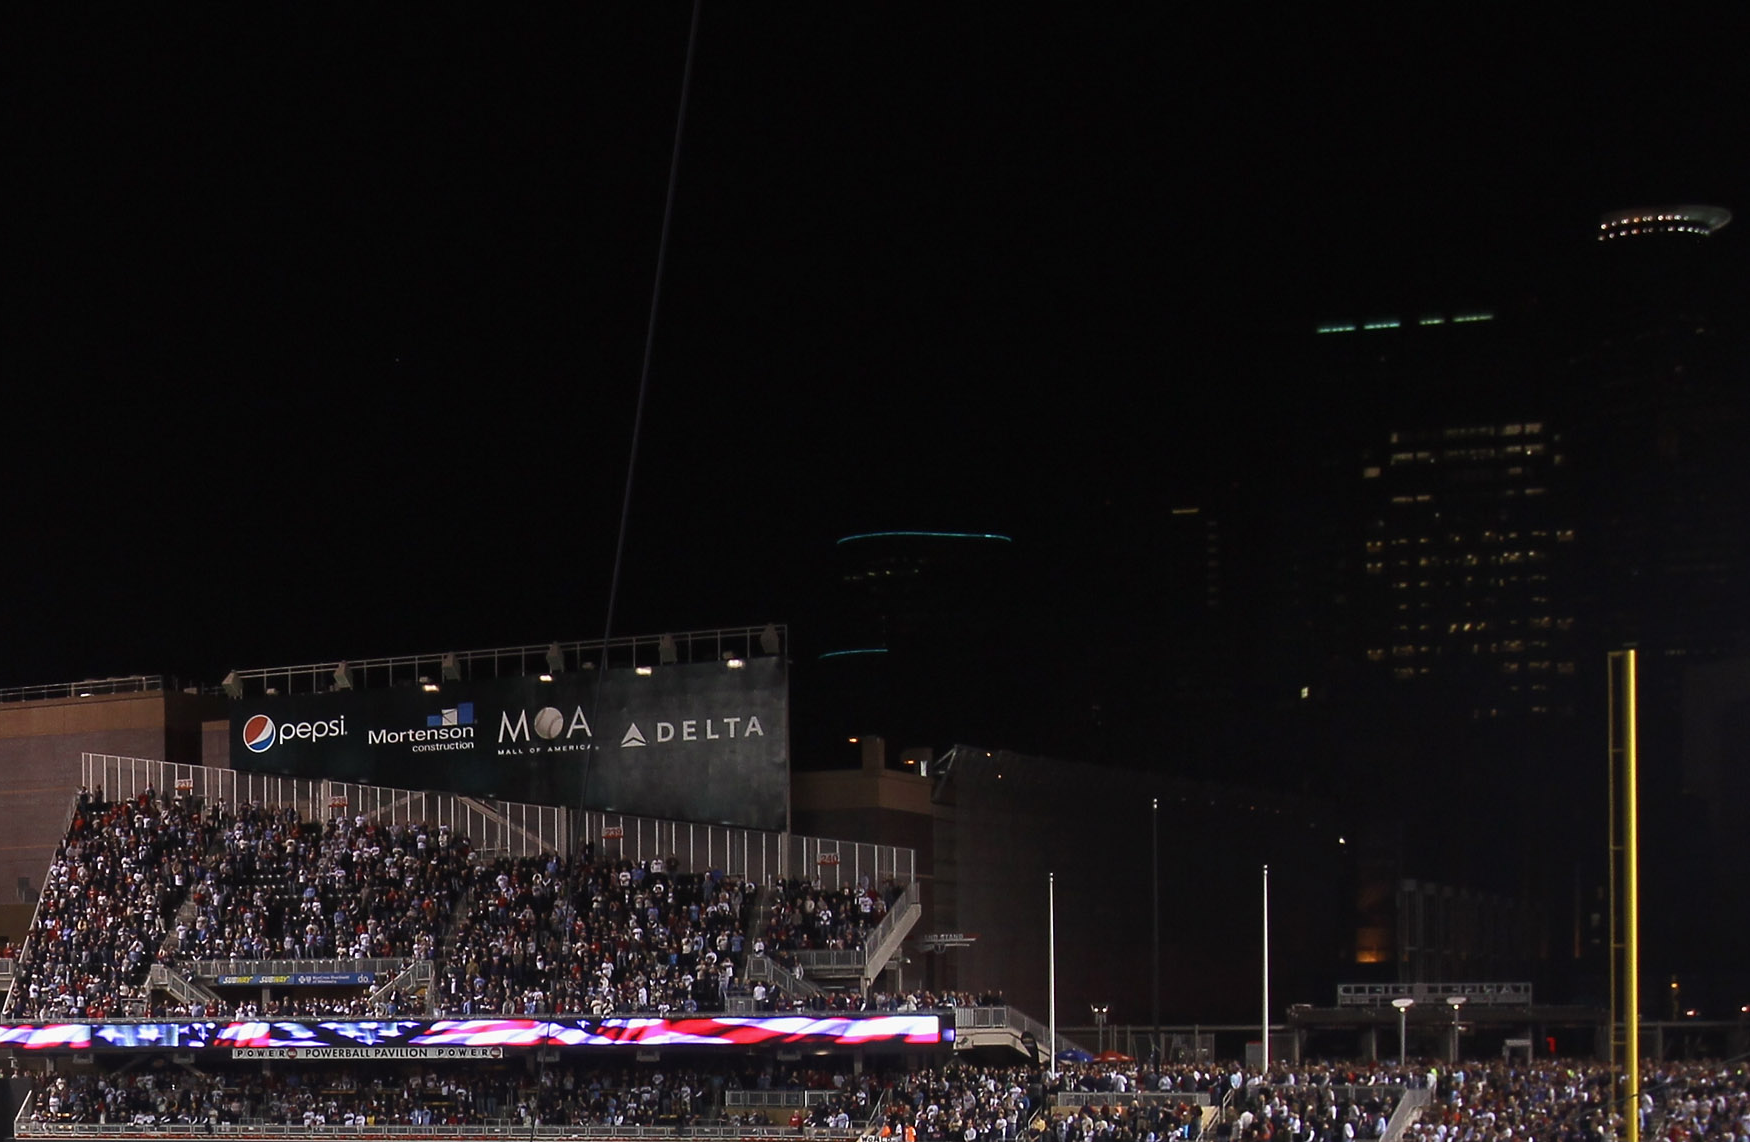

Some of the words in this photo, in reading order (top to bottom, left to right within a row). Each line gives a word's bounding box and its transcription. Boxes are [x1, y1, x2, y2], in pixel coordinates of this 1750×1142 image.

[279, 715, 345, 744] pepsi
[657, 716, 764, 743] DELTA
[368, 726, 474, 745] Mortenson
[412, 741, 474, 753] construction
[821, 854, 838, 863] 240
[223, 976, 253, 984] SUBWAY
[259, 976, 290, 984] SUBWAY
[237, 1049, 285, 1058] POWER
[305, 1048, 370, 1058] POWERBALL
[374, 1048, 428, 1058] PAVILION
[437, 1048, 488, 1057] POWER
